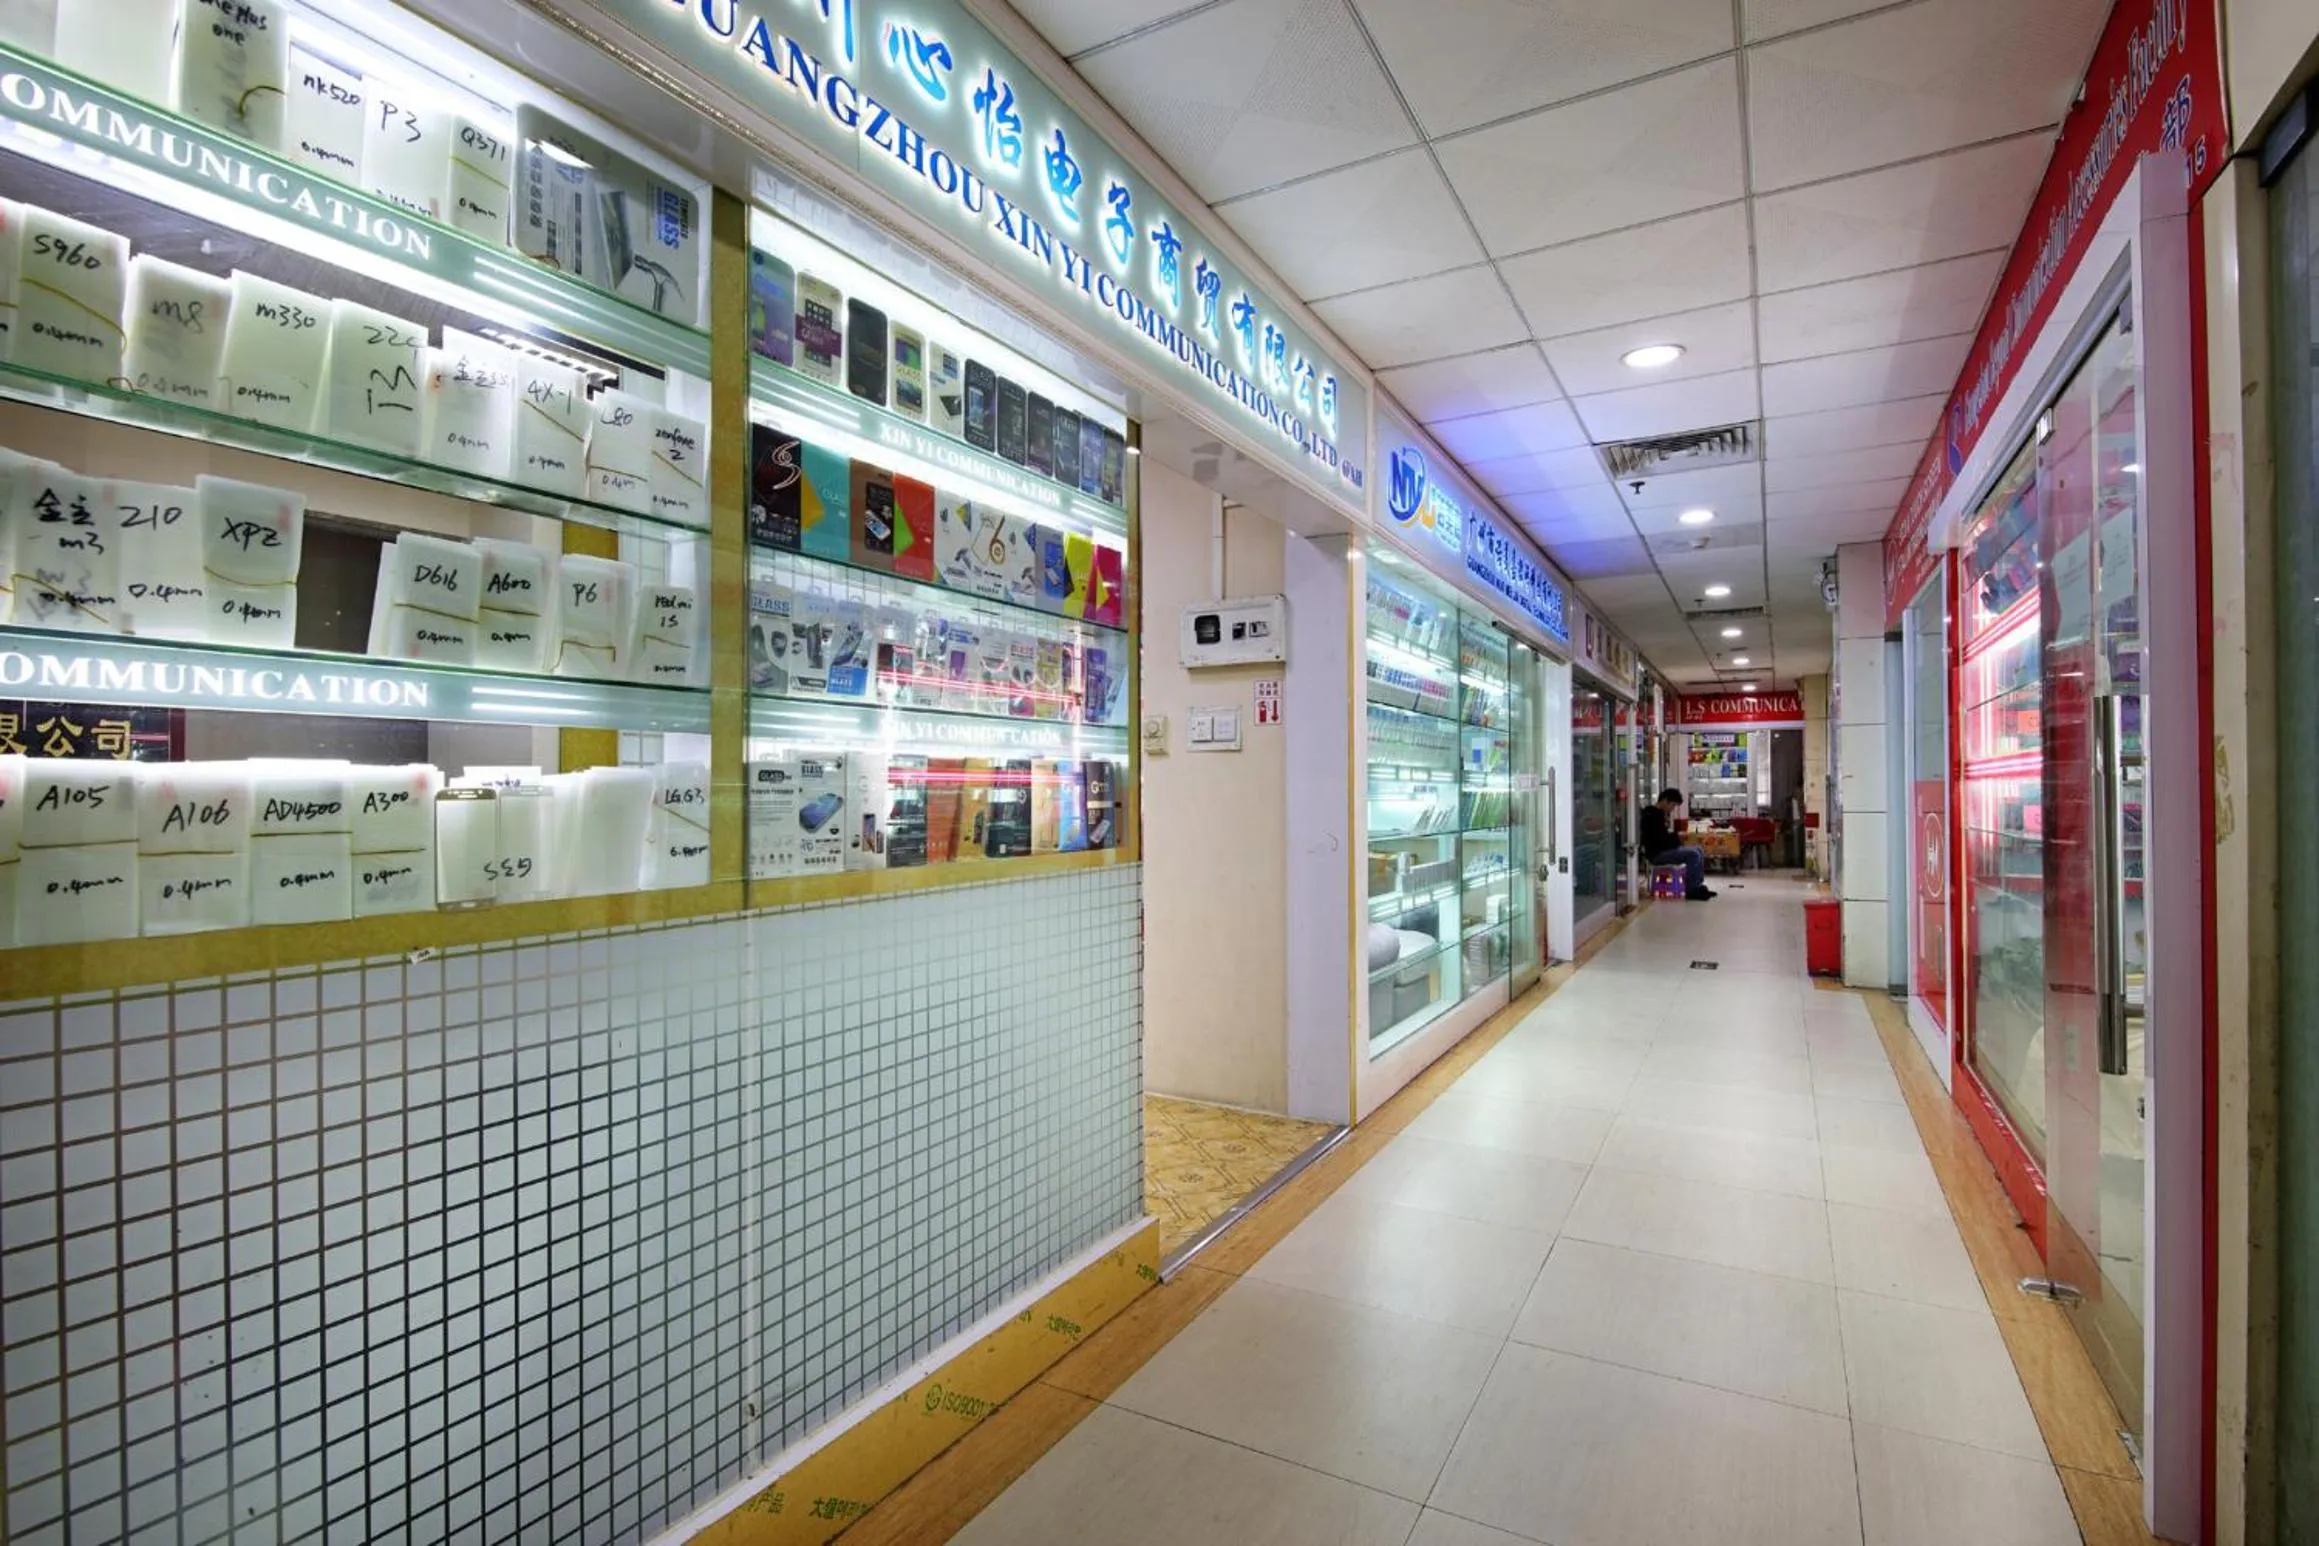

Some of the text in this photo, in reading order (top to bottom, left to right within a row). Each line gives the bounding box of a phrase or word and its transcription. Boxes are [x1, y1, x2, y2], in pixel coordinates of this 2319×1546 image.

[460, 125, 506, 161] Q371
[662, 189, 681, 251] GLASS
[664, 0, 985, 213] UANGZHOU
[993, 191, 1055, 270] XIN
[1054, 236, 1093, 296] YI
[1097, 272, 1281, 430] COMMUNICATION
[413, 563, 459, 592] D616
[36, 784, 111, 812] A105
[161, 798, 231, 834] A106
